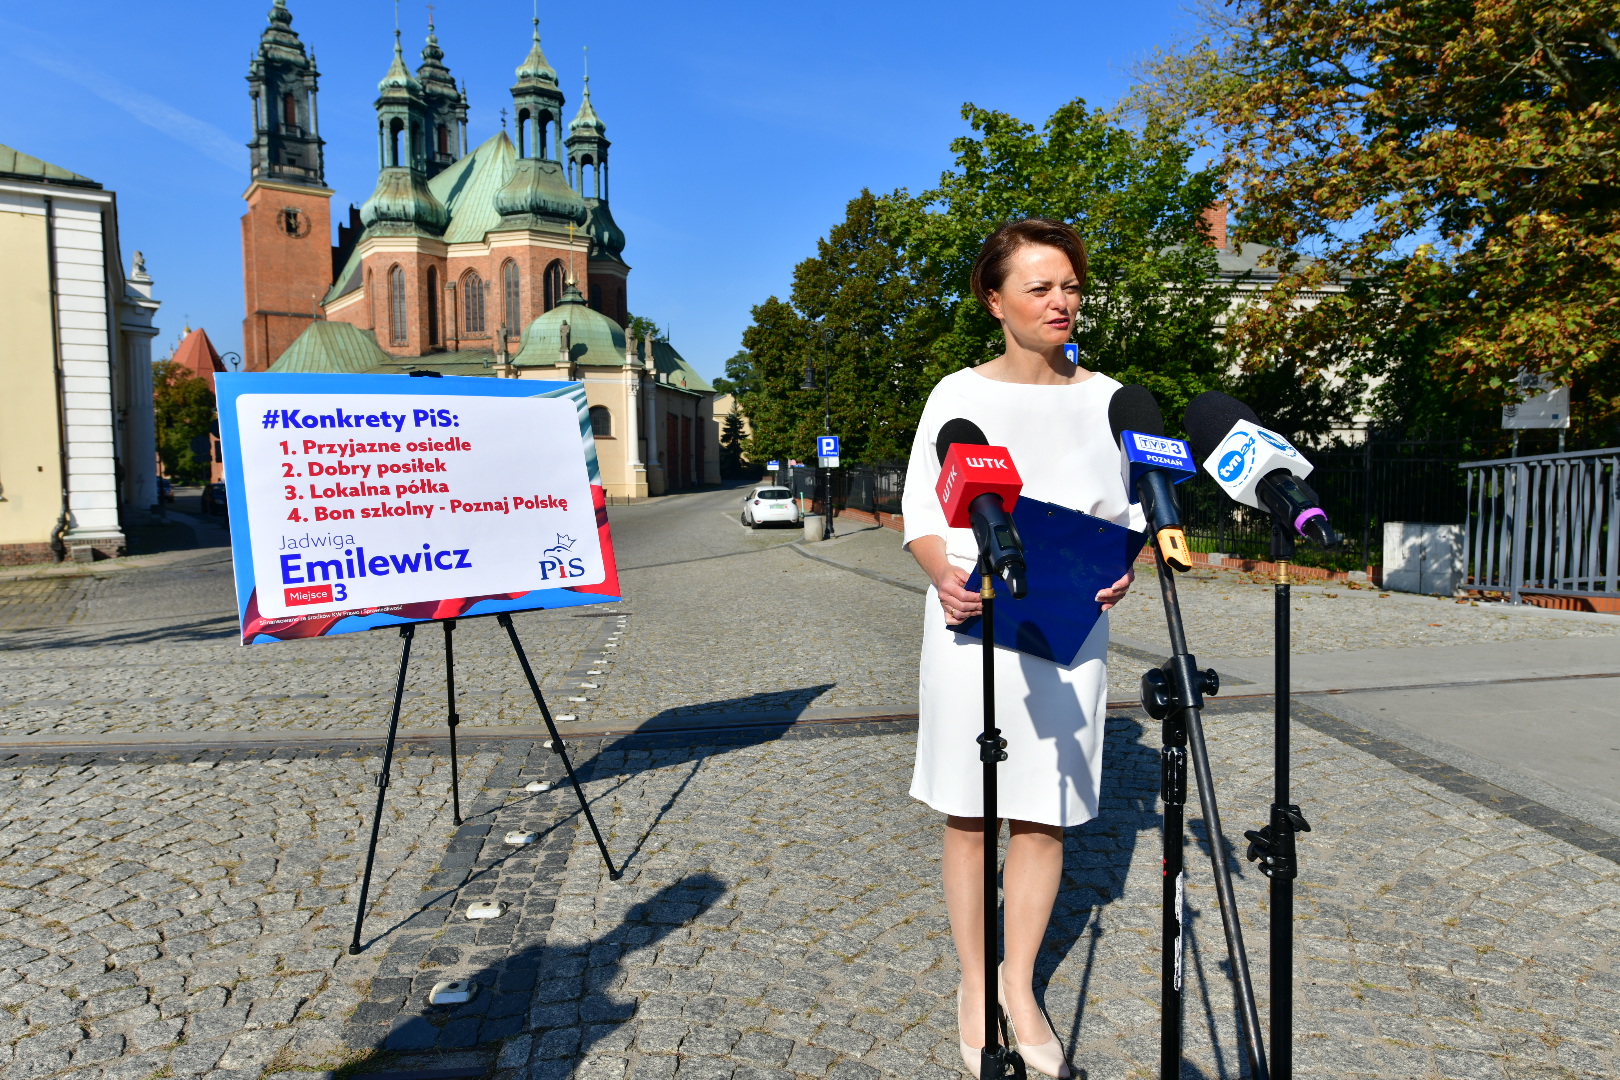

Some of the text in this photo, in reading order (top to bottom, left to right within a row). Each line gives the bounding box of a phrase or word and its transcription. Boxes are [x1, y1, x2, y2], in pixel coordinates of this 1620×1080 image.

[262, 408, 460, 432] #Konkrety PiS:
[279, 437, 471, 458] 1. Przyjazne osiedle
[281, 458, 447, 478] 2. Dobry posiłek
[966, 457, 1008, 469] WTK
[1145, 454, 1183, 467] POZNAŃ
[284, 479, 449, 500] 3. Lokalna półka
[287, 507, 308, 523] 4.
[314, 506, 355, 522] Bon
[361, 501, 434, 519] szkolny
[450, 497, 509, 515] Poznaj
[513, 495, 568, 511] Polskę
[279, 532, 355, 550] Jadwiga
[280, 543, 472, 584] Emilewicz
[538, 557, 585, 580] PiS
[290, 583, 348, 602] Miejsce 3
